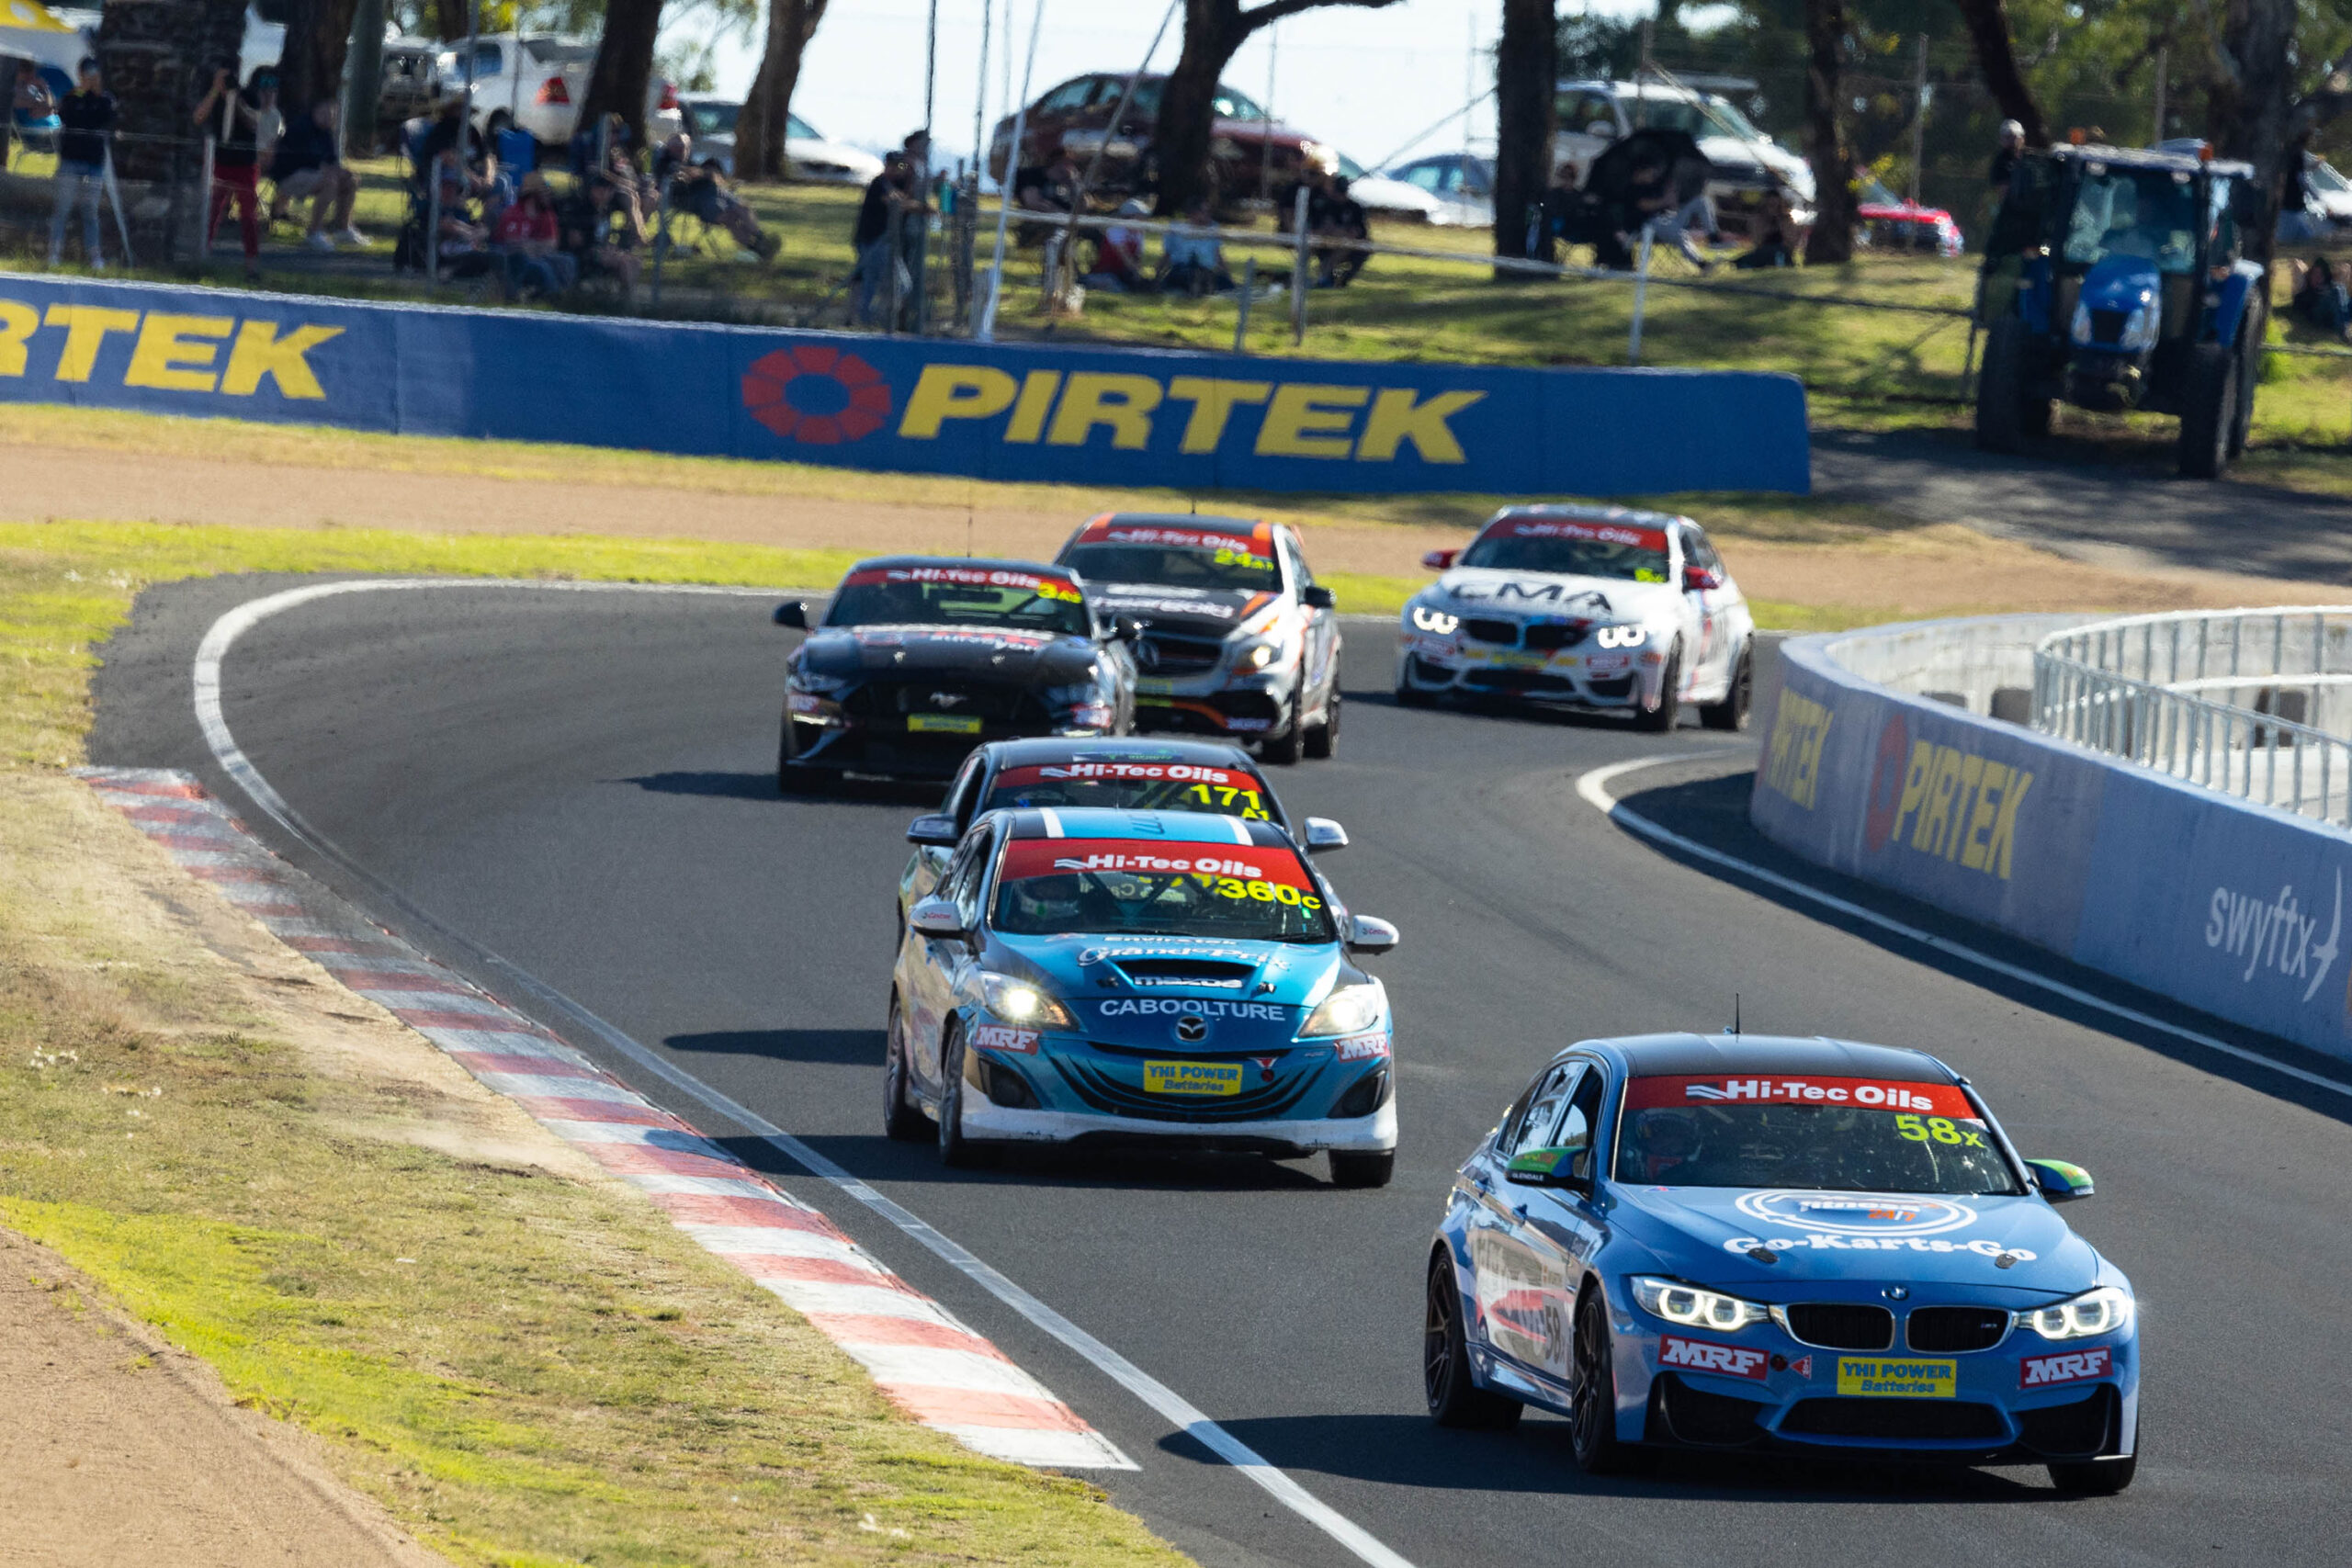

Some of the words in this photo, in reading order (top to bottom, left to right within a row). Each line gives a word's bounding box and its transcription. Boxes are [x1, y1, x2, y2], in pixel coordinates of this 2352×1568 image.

[898, 364, 1487, 465] PIRTEK
[911, 568, 986, 583] Hi-Tec
[989, 570, 1041, 589] Oils
[1069, 763, 1163, 778] Hi-Tec
[1167, 765, 1229, 784] Oils
[1191, 784, 1261, 810] 171
[1892, 740, 2035, 880] PIRTEK
[1088, 854, 1191, 871] Hi-Tec
[1194, 857, 1262, 878] Oils
[2206, 885, 2317, 983] swyftx
[1100, 998, 1286, 1021] CABOOLTURE
[977, 1026, 1039, 1050] MRF
[1340, 1032, 1388, 1060] MRF
[1148, 1065, 1176, 1078] YHI
[1180, 1066, 1239, 1082] POWER
[1163, 1078, 1225, 1092] Batteries
[1726, 1080, 1849, 1101] Hi-Tec
[1855, 1086, 1934, 1111] Oils
[1723, 1235, 2038, 1261] Go-Karts-Go
[1662, 1337, 1764, 1375] MRF
[2025, 1349, 2109, 1384] MRF
[1843, 1361, 1880, 1378] YHI
[1883, 1363, 1952, 1379] POWER
[1860, 1379, 1936, 1393] Batteries
